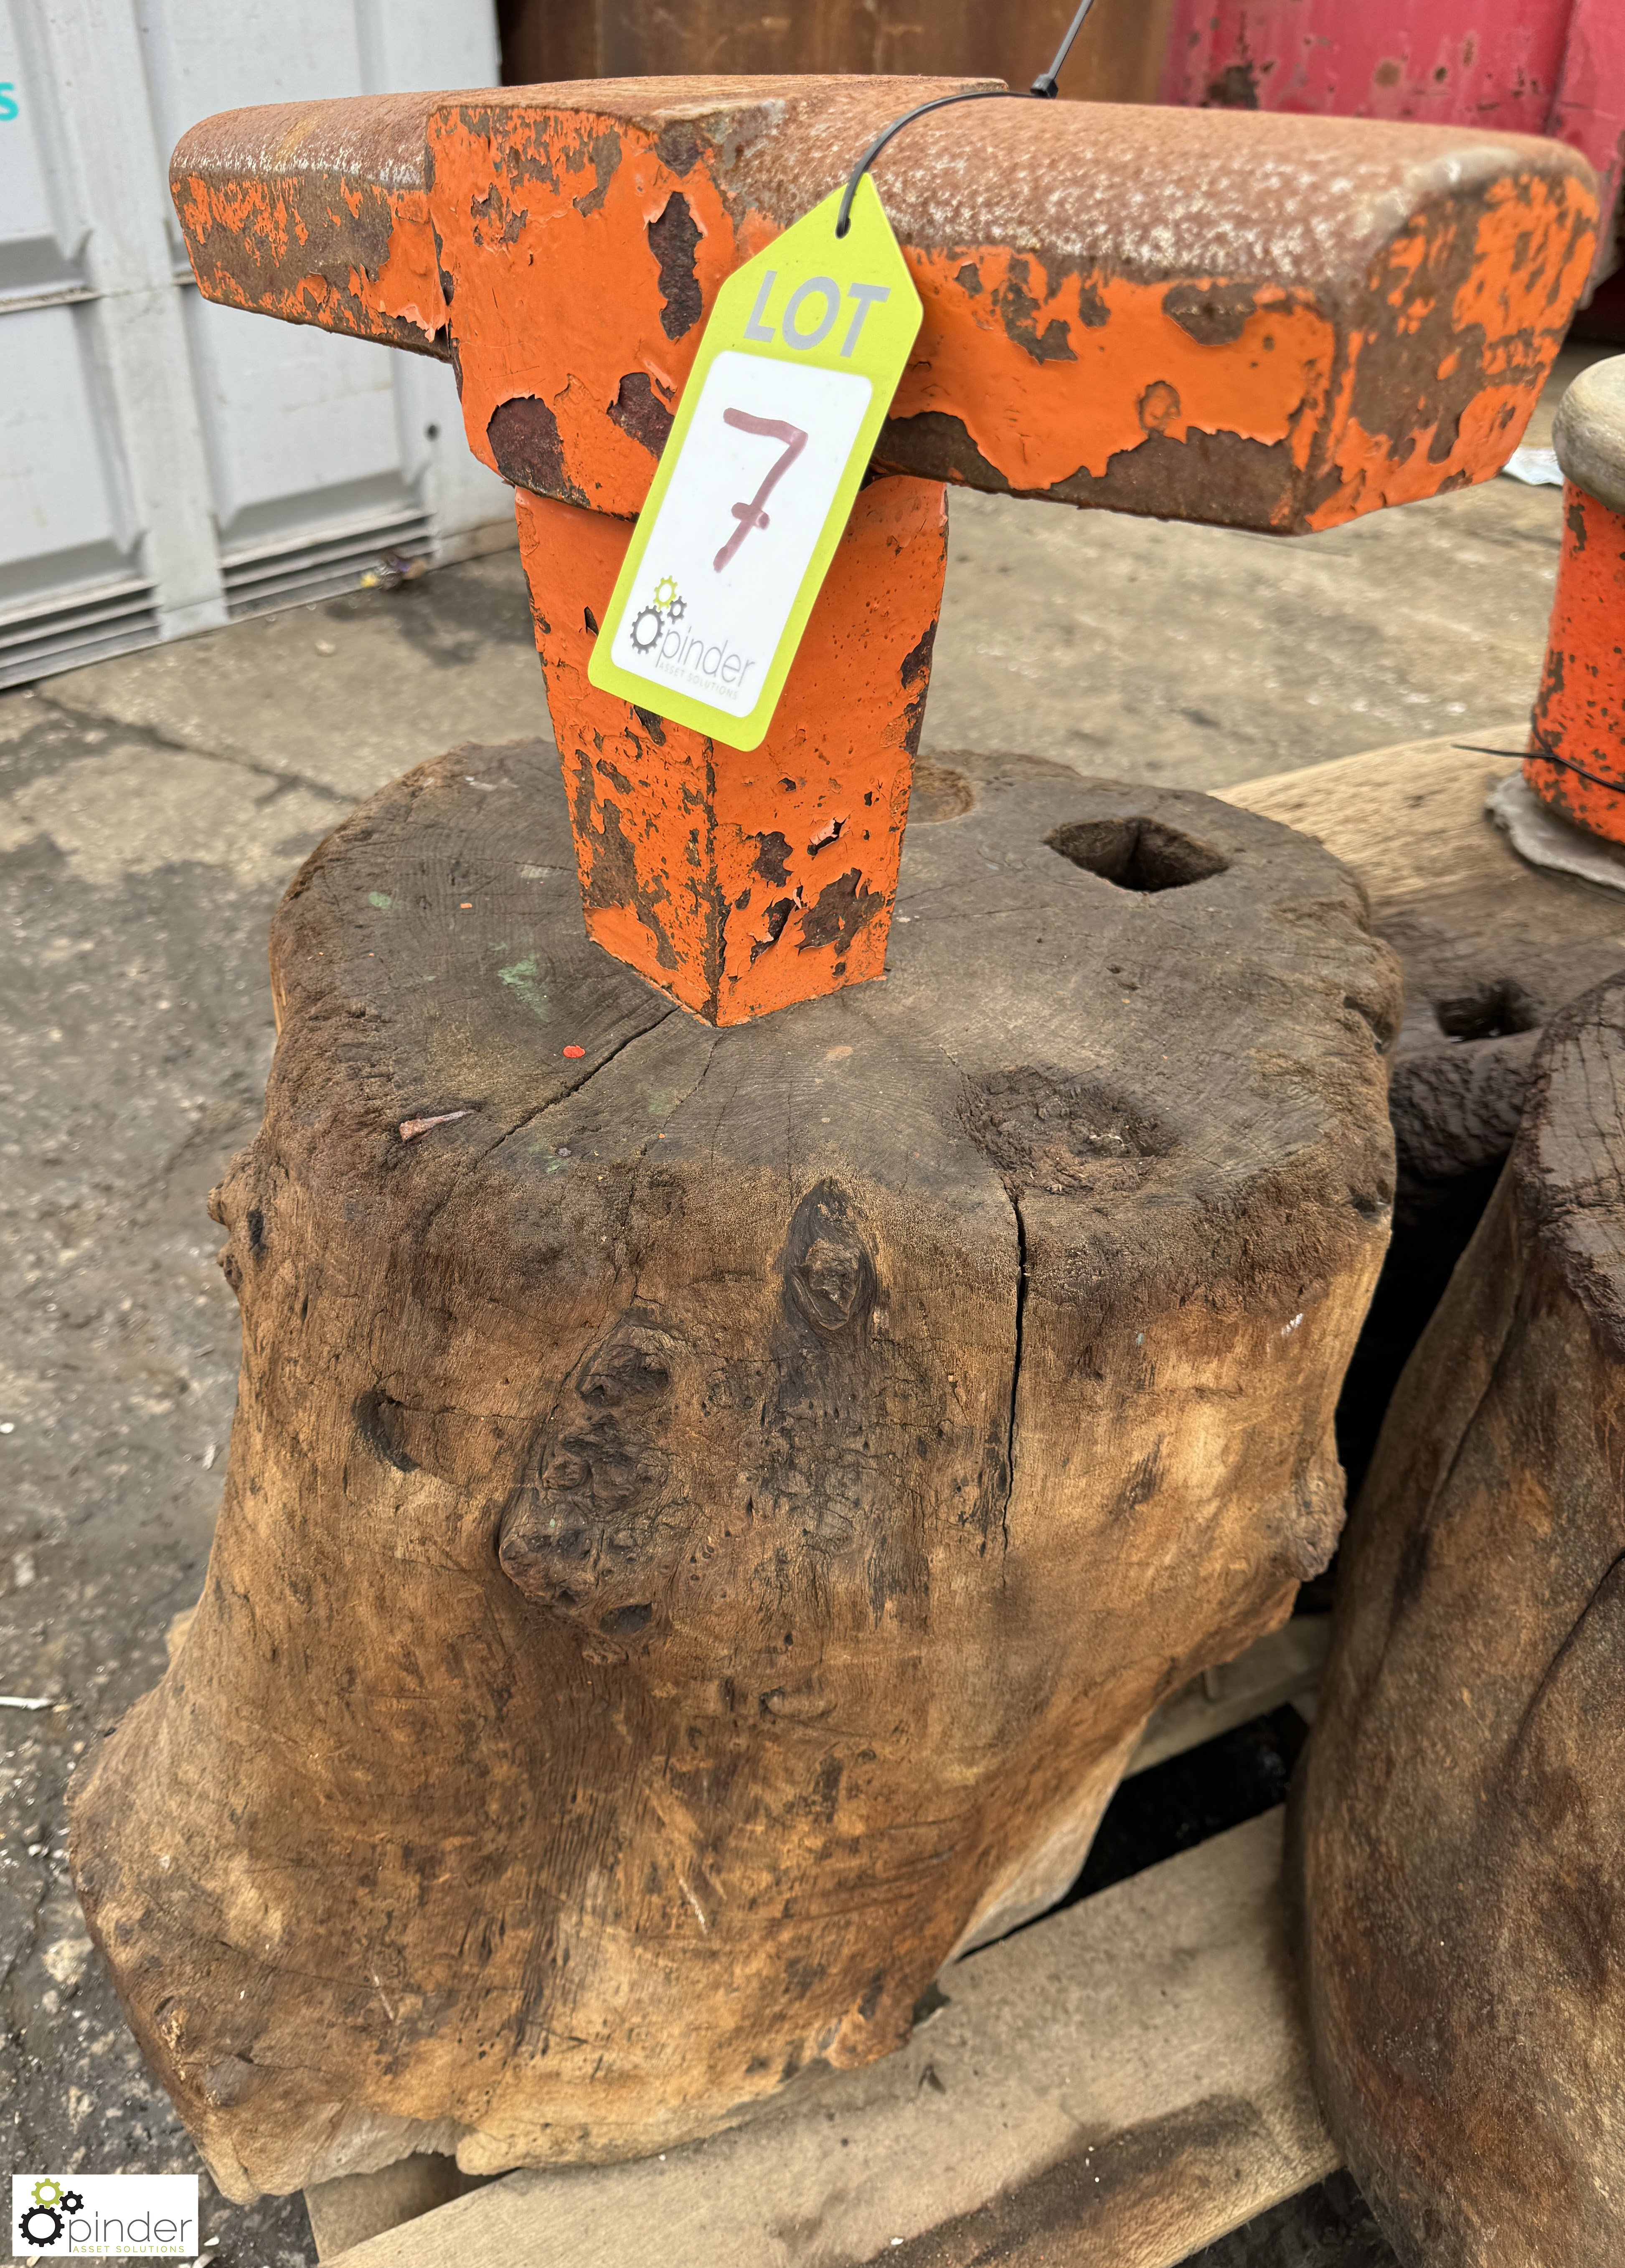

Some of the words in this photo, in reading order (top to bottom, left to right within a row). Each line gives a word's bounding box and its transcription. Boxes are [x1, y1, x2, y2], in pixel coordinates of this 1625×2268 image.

[743, 270, 891, 358] LOT
[713, 407, 808, 573] 7
[655, 626, 755, 687] pinder
[659, 662, 685, 678] ASSET
[688, 673, 739, 700] SOLUTIONS
